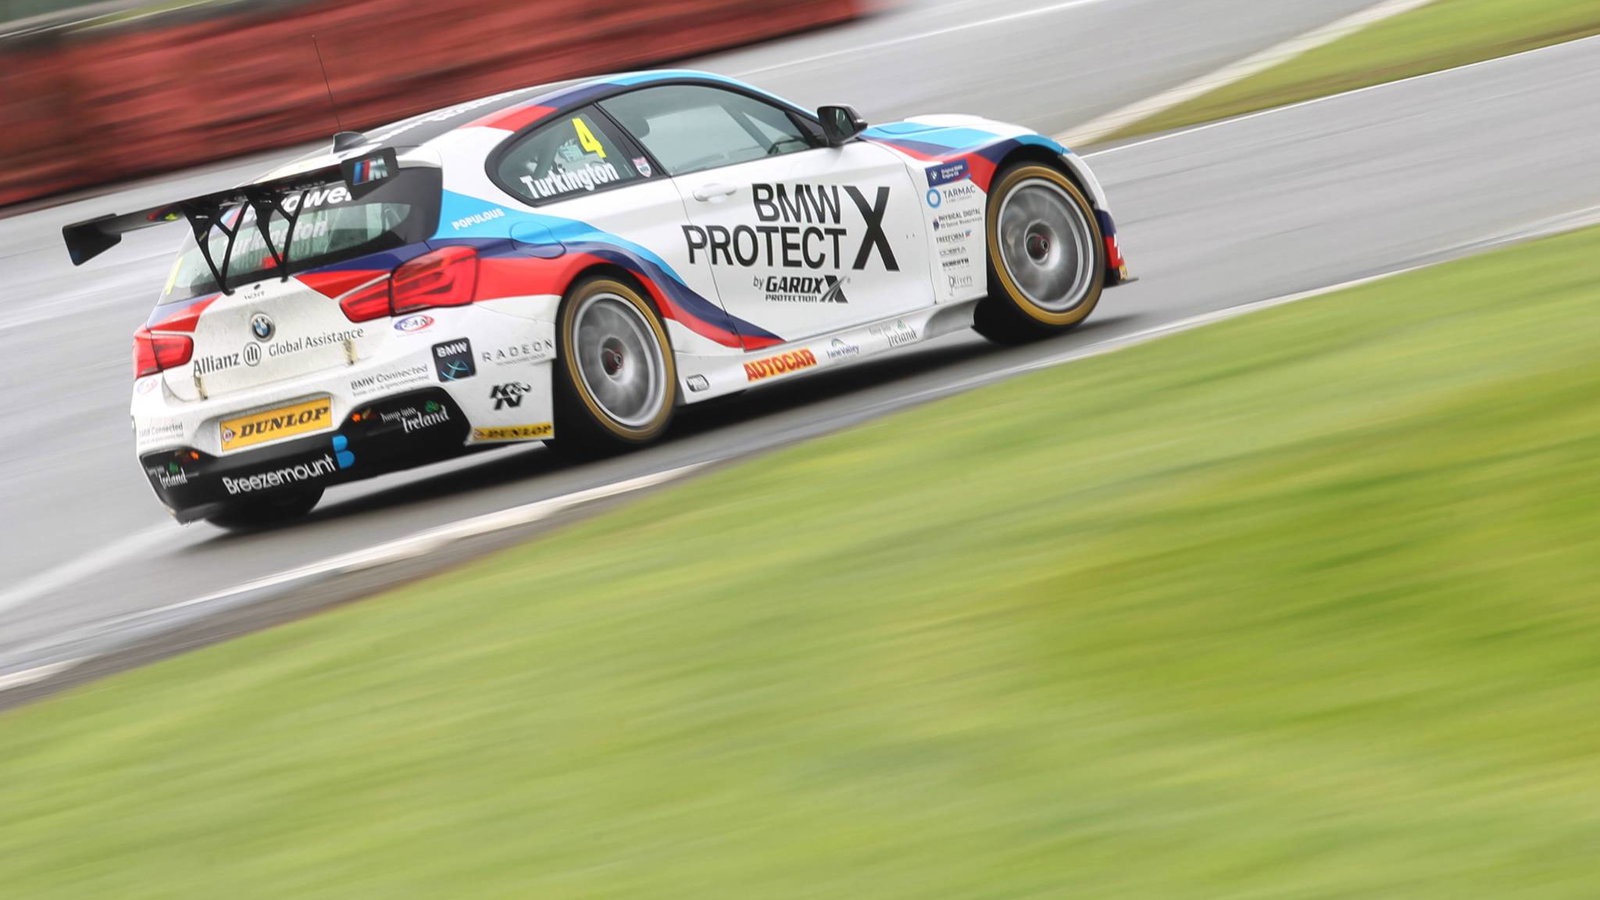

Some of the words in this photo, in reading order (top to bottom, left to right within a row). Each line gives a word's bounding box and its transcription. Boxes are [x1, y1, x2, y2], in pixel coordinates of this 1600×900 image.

[572, 117, 607, 159] 4
[520, 162, 620, 199] Turkington
[943, 184, 976, 199] TARMAC
[451, 207, 505, 231] POPULOUS
[752, 183, 841, 224] BMW
[843, 185, 900, 272] X
[681, 225, 847, 269] PROTECT
[753, 275, 765, 290] by
[765, 294, 817, 303] PROTECTION
[192, 352, 241, 377] Allianz
[268, 334, 302, 357] Global
[305, 326, 365, 348] Assistance
[436, 341, 468, 358] BMW
[482, 338, 553, 362] RADEON
[743, 348, 818, 382] AUTOCAR
[350, 375, 376, 391] BMW
[238, 406, 330, 438] DUNLOP
[401, 404, 450, 434] Ireland
[222, 452, 336, 496] Breezemount
